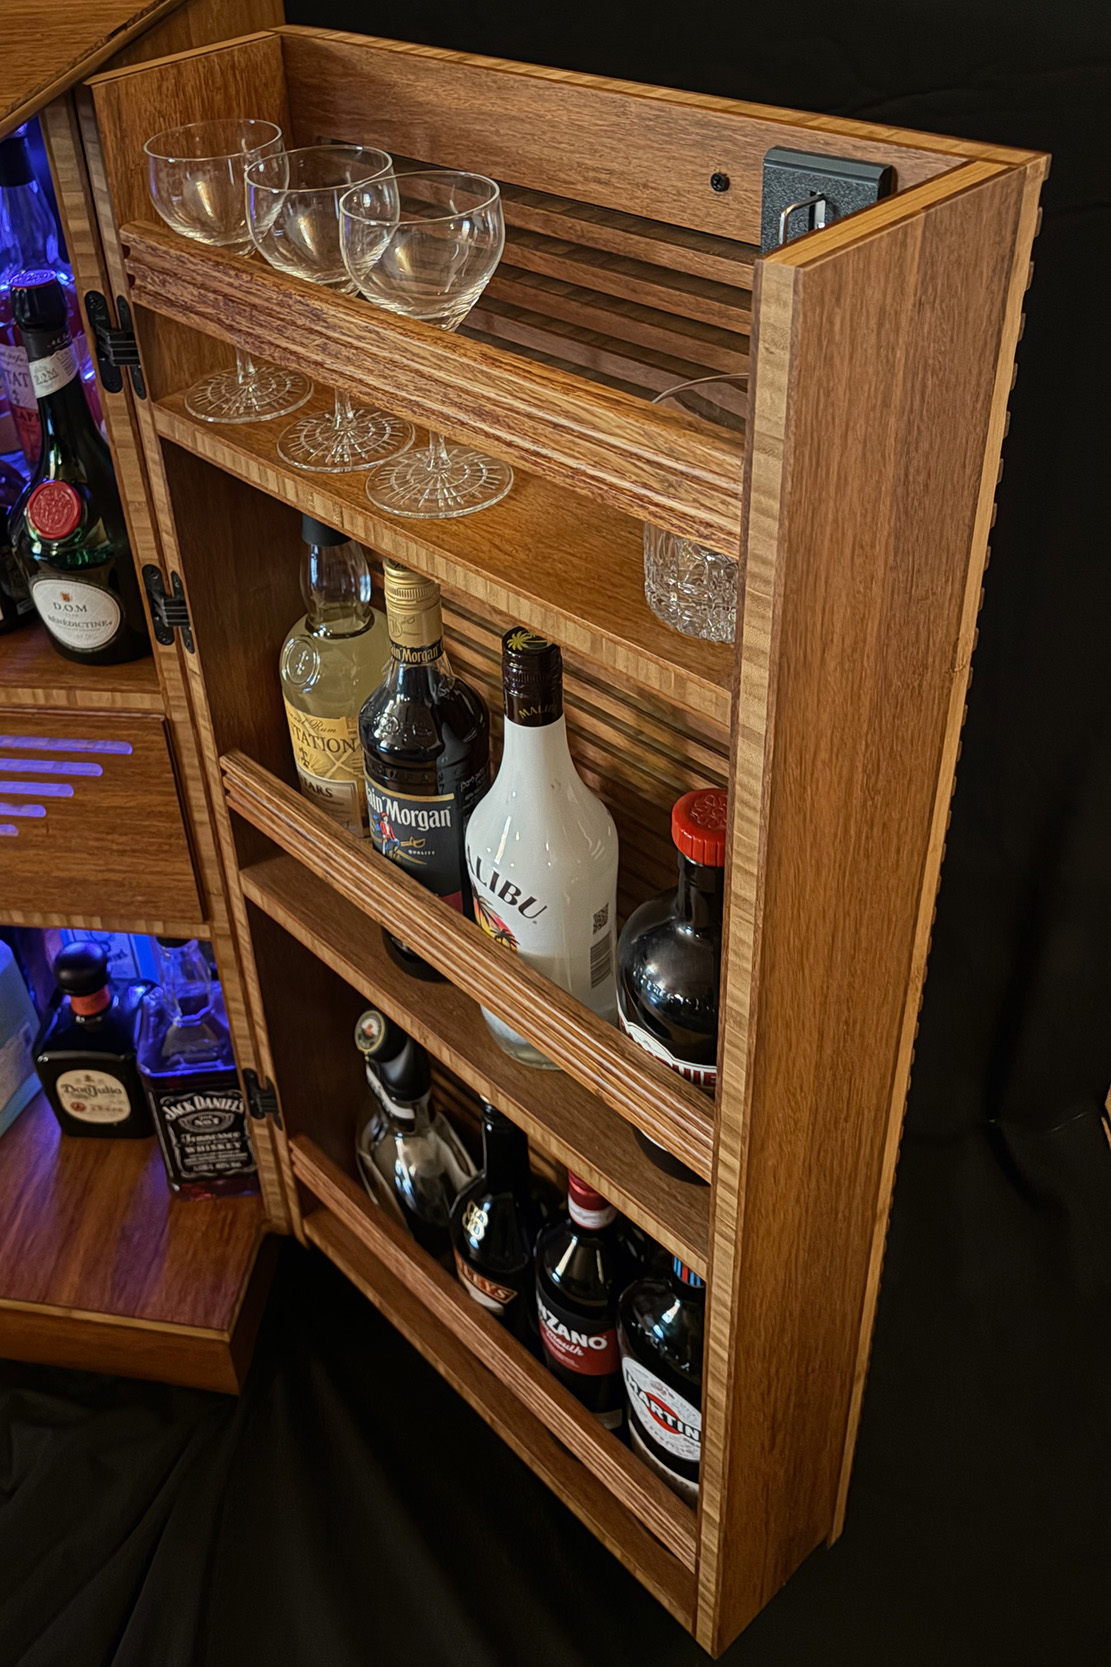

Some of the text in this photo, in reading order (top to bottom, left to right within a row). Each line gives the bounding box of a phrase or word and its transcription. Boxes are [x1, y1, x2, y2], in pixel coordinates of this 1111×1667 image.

[402, 645, 439, 664] Morgan
[292, 723, 359, 754] TATION
[310, 719, 337, 734] Rum
[366, 782, 384, 813] ain
[384, 796, 452, 832] Morgan
[162, 1100, 196, 1121] JACK
[625, 1370, 700, 1442] MARTIN
